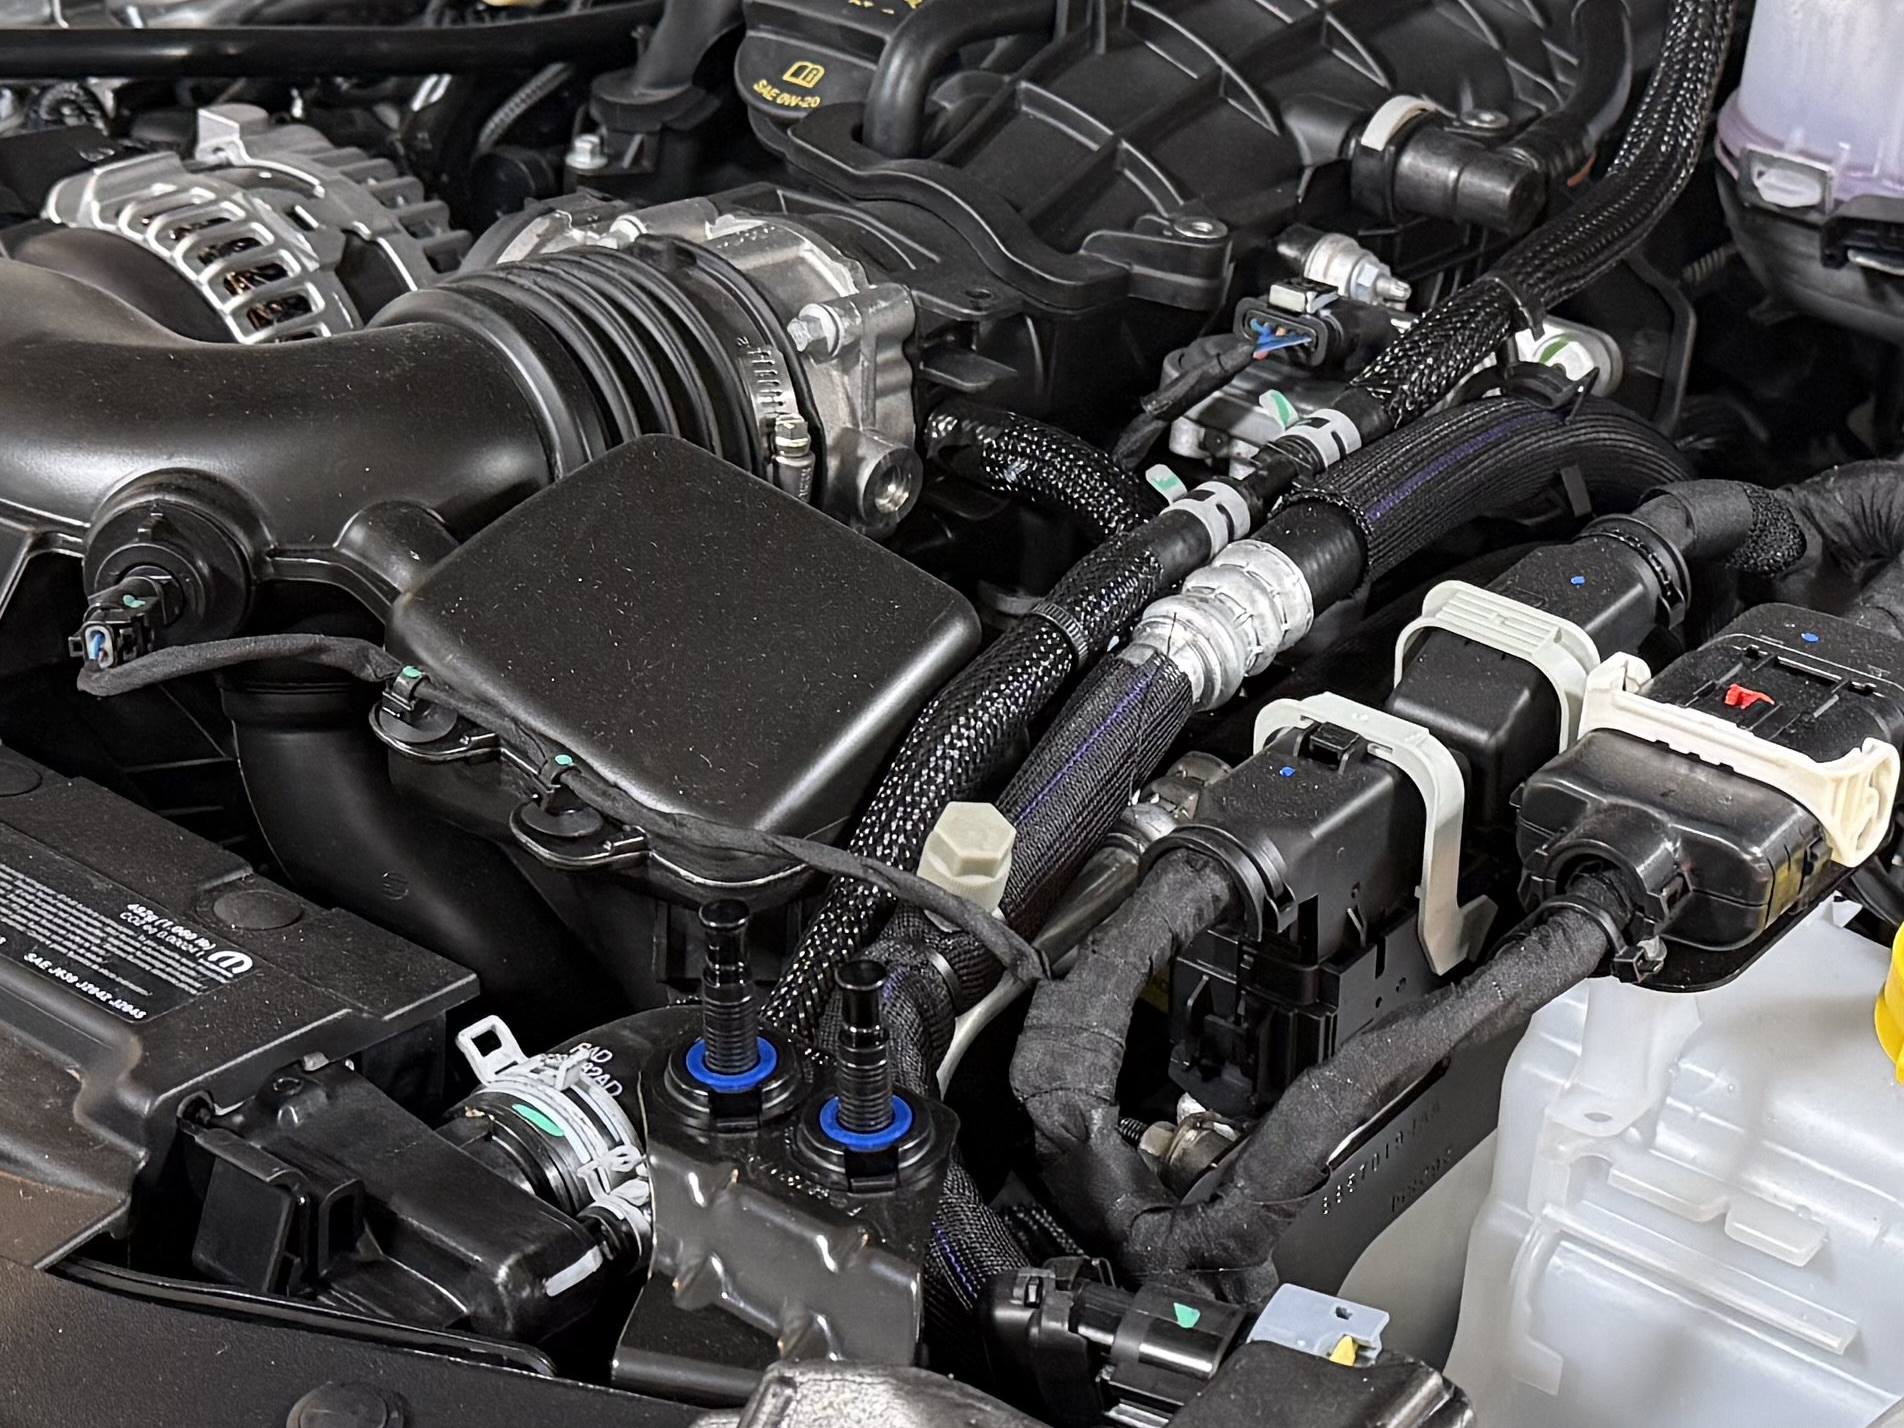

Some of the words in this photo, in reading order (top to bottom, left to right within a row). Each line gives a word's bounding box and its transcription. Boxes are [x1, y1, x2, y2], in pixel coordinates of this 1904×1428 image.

[753, 78, 779, 102] SAE
[775, 93, 821, 109] 0W-20
[23, 952, 53, 970] SAE
[47, 966, 79, 984] J639
